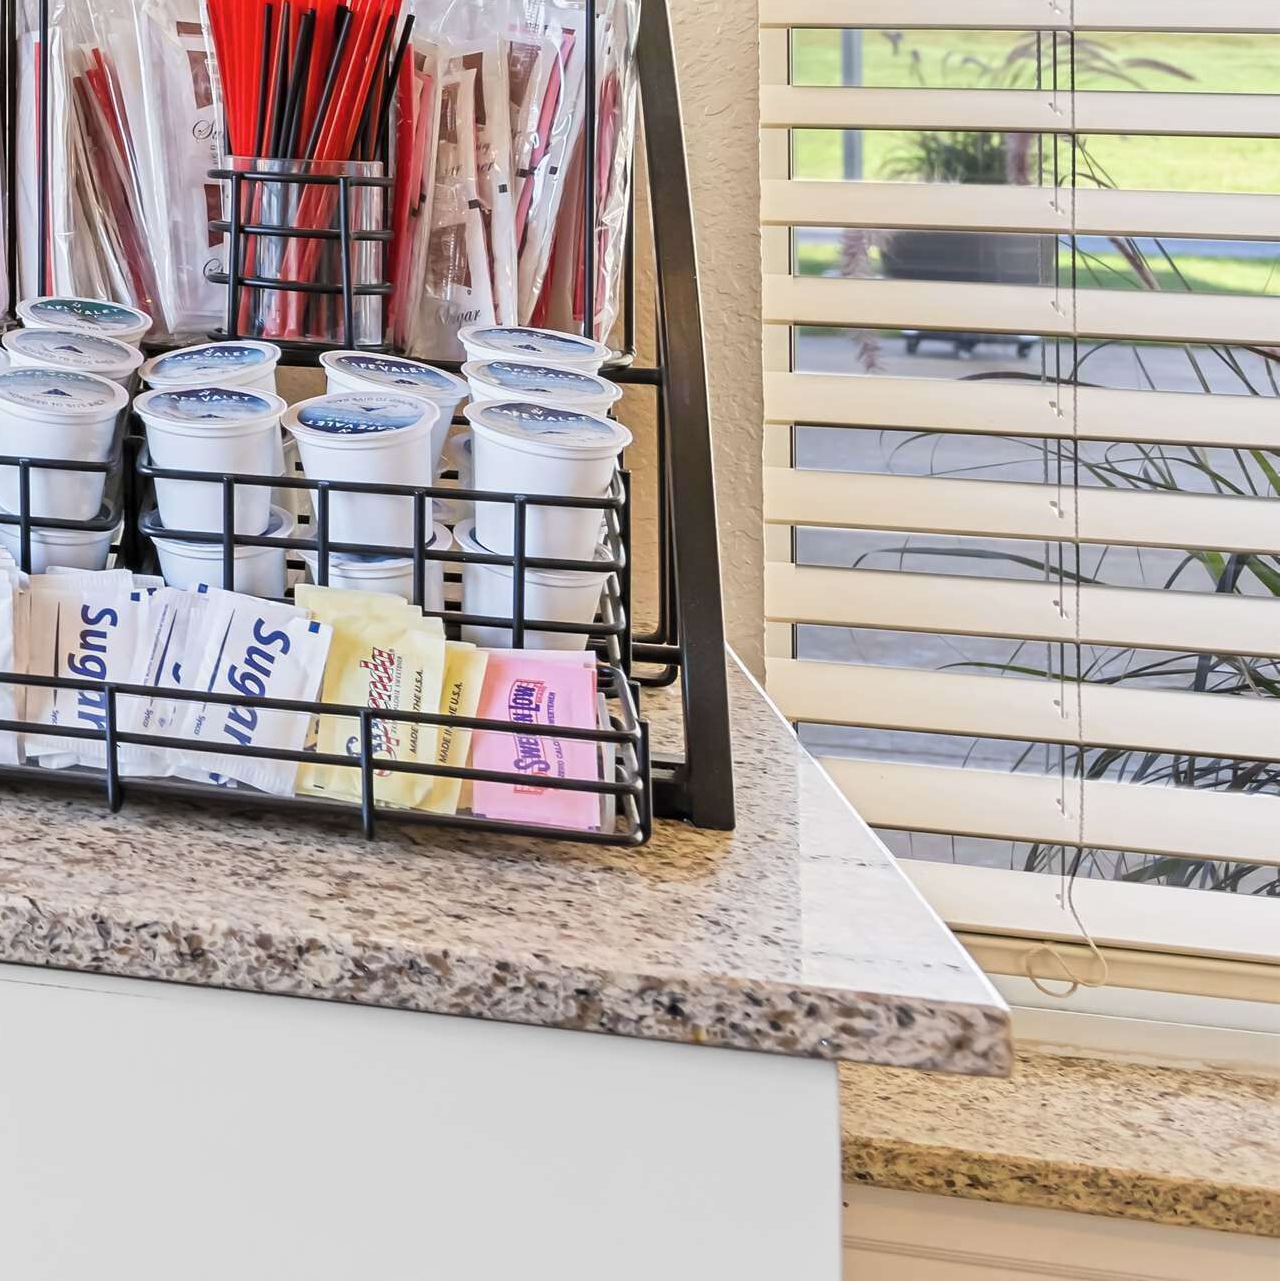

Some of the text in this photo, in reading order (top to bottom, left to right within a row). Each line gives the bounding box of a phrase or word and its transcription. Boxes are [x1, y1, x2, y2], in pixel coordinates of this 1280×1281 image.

[413, 692, 421, 713] THE
[439, 735, 452, 763] MADE
[451, 681, 463, 706] U.S.A.
[409, 727, 419, 754] MADE
